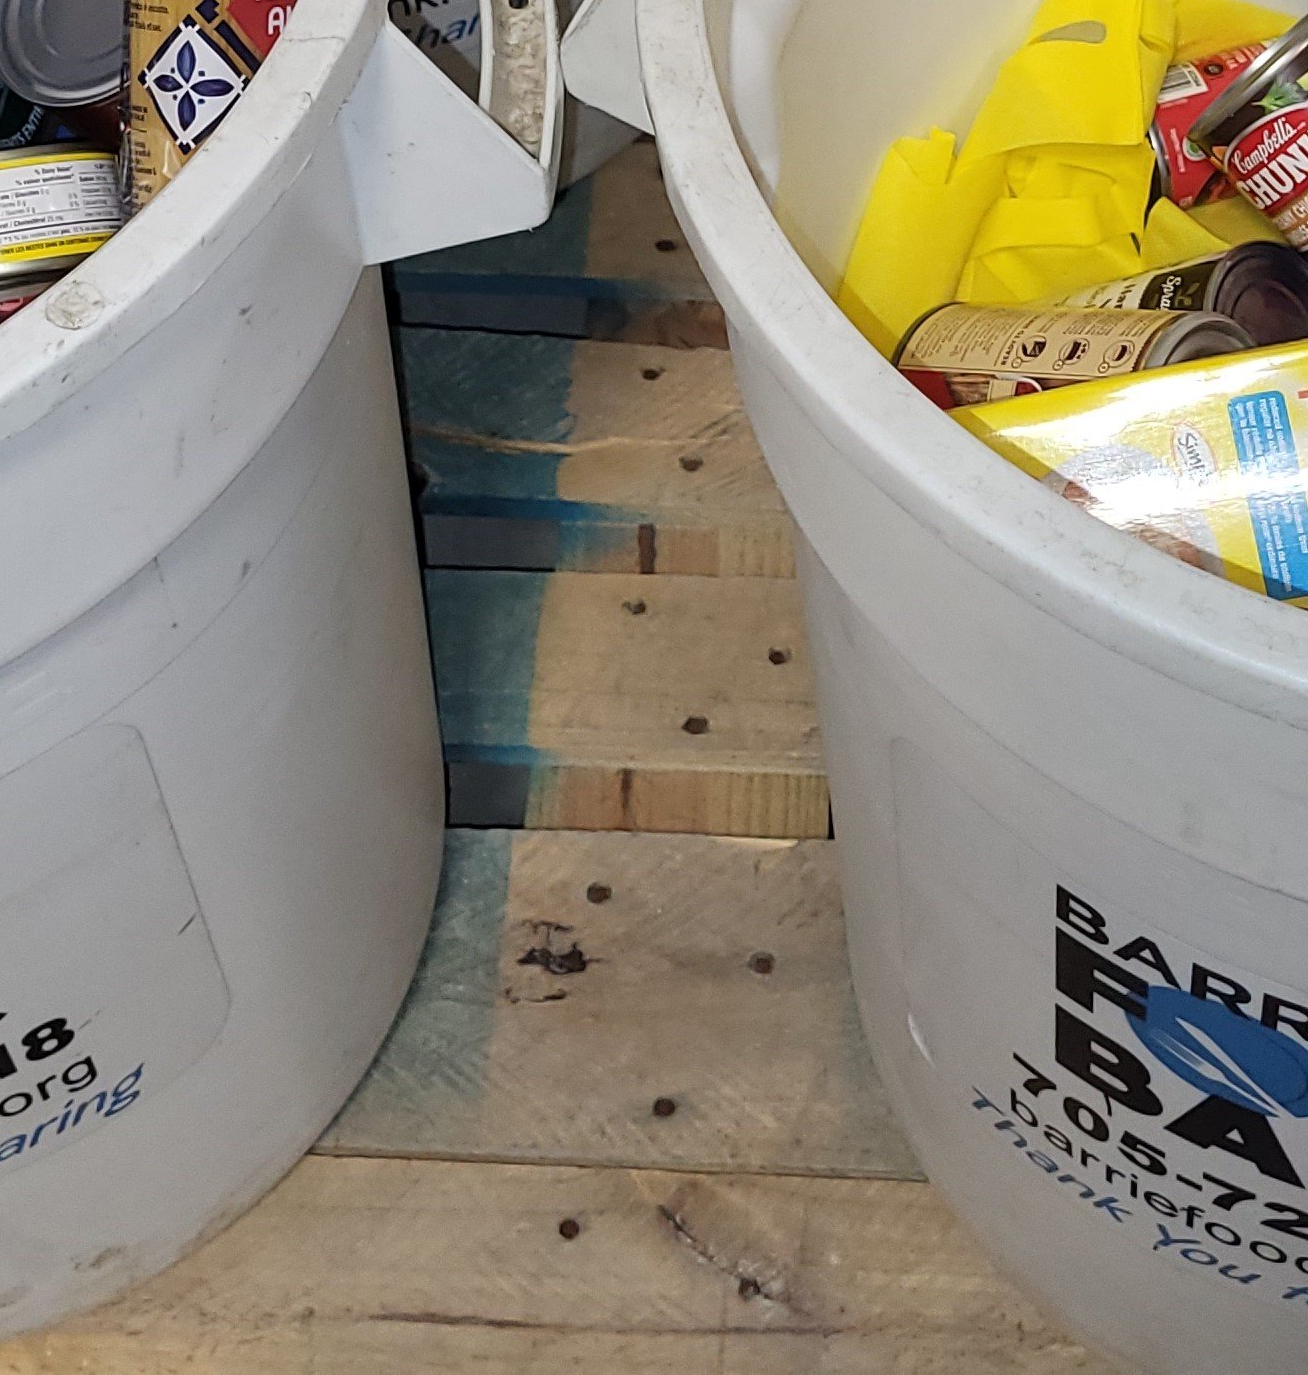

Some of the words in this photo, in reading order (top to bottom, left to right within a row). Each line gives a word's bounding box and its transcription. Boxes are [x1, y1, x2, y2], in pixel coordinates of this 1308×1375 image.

[1233, 116, 1301, 175] Campbell's
[971, 1086, 1134, 1224] Thank
[1152, 1226, 1261, 1287] You
